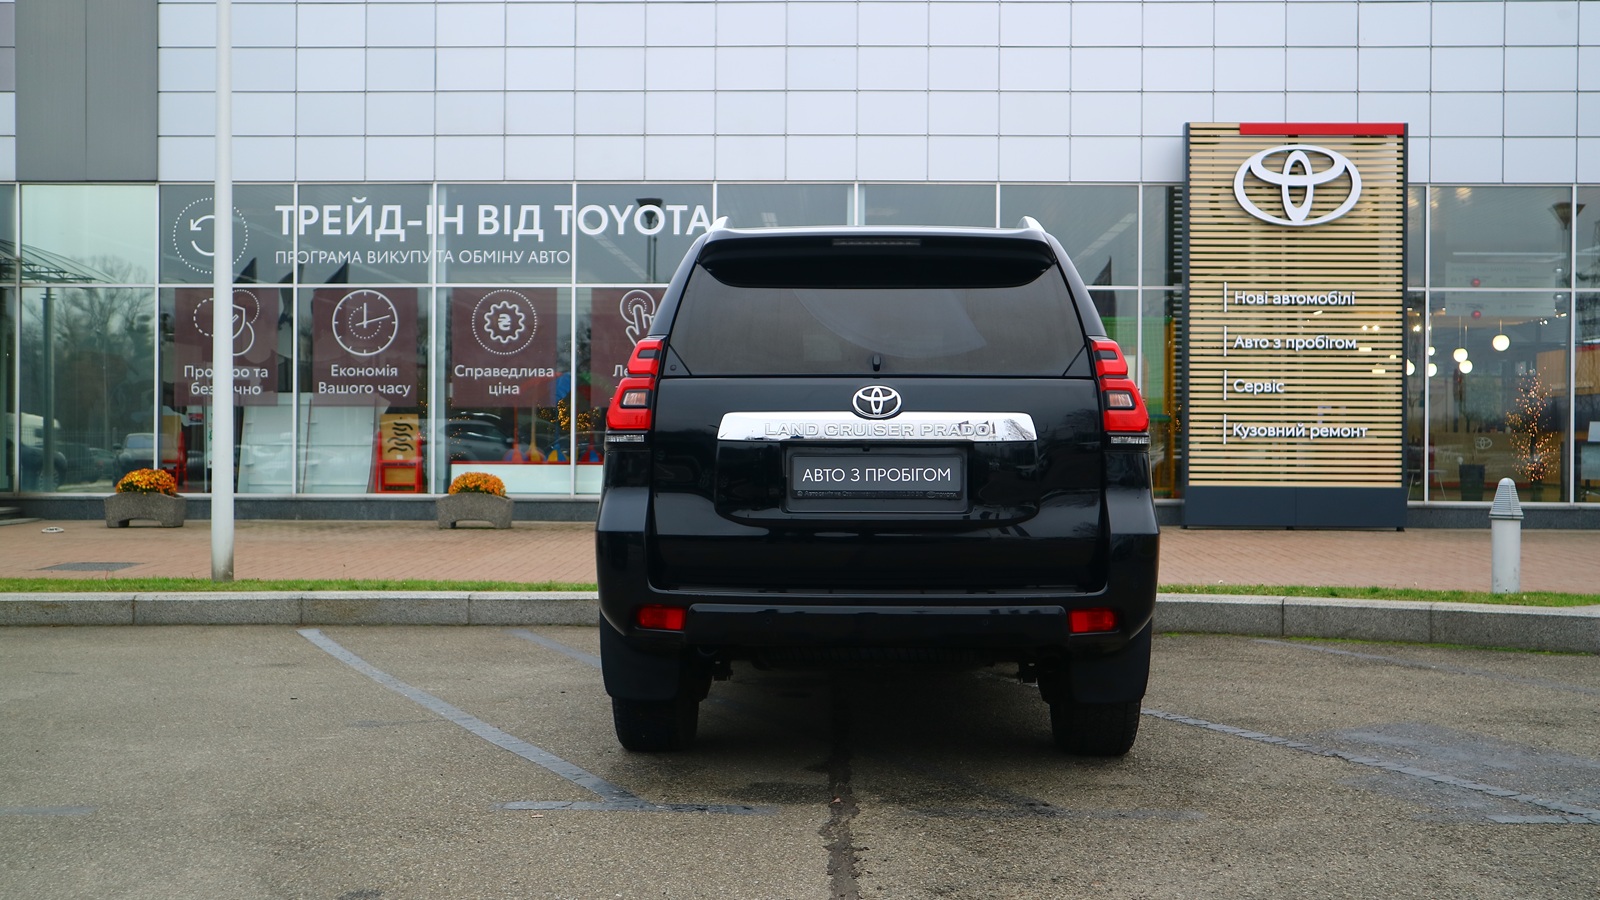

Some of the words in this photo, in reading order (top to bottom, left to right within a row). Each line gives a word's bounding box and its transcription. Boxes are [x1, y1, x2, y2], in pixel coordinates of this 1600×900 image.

[275, 197, 463, 242] ТРЕЙД-ІН
[478, 205, 544, 242] ВІД
[554, 204, 711, 236] TOYOTA
[275, 251, 362, 264] ПРОГРАМА
[367, 251, 432, 264] ВИКУПУ
[437, 250, 454, 263] ТА
[458, 250, 523, 264] ОБМІНУ
[528, 251, 570, 264] АВТО
[1234, 291, 1268, 305] Нові
[1272, 291, 1356, 305] автомобілі
[1233, 335, 1269, 349] Авто
[1273, 338, 1281, 349] з
[1285, 335, 1357, 352] пробігом
[184, 365, 250, 380] Проро
[253, 368, 269, 378] та
[331, 364, 398, 377] Економія
[454, 364, 554, 380] Справедлива
[191, 382, 262, 395] безчно
[318, 382, 374, 394] Вашого
[377, 385, 411, 397] часу
[488, 382, 520, 396] ціна
[1233, 379, 1285, 395] Сервіс
[765, 423, 819, 437] LAND
[824, 423, 914, 437] CRUISER
[920, 423, 990, 437] PRADO
[1233, 423, 1306, 439] Кузовний
[1310, 426, 1368, 440] ремонт
[802, 468, 846, 482] АВТО
[865, 468, 951, 482] ПРОБІГОМ
